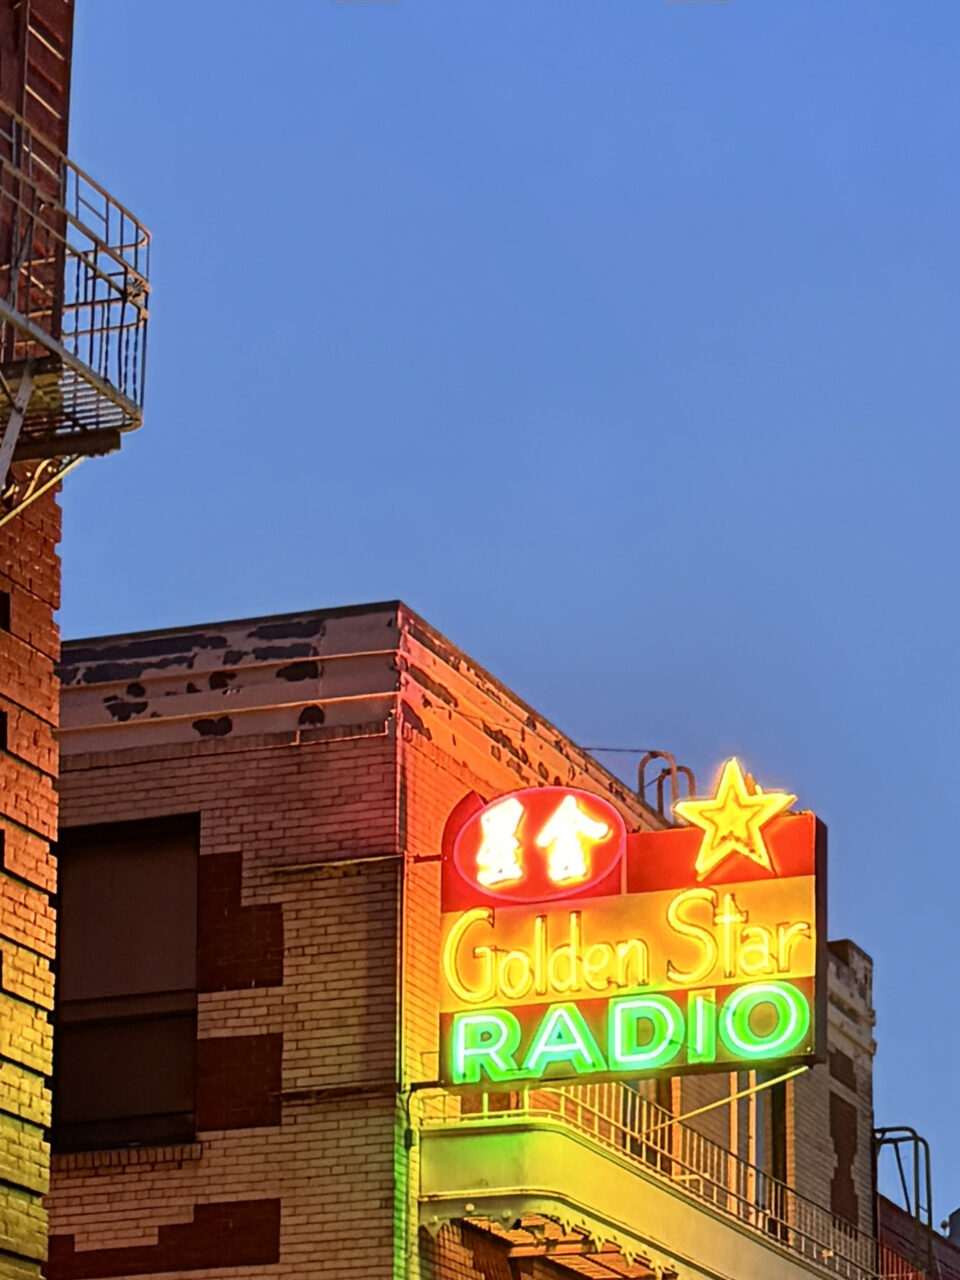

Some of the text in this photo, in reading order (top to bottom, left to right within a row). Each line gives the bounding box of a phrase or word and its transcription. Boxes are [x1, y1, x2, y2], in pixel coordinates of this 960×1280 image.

[443, 887, 812, 1004] Golden Star
[451, 980, 811, 1084] RADIO
